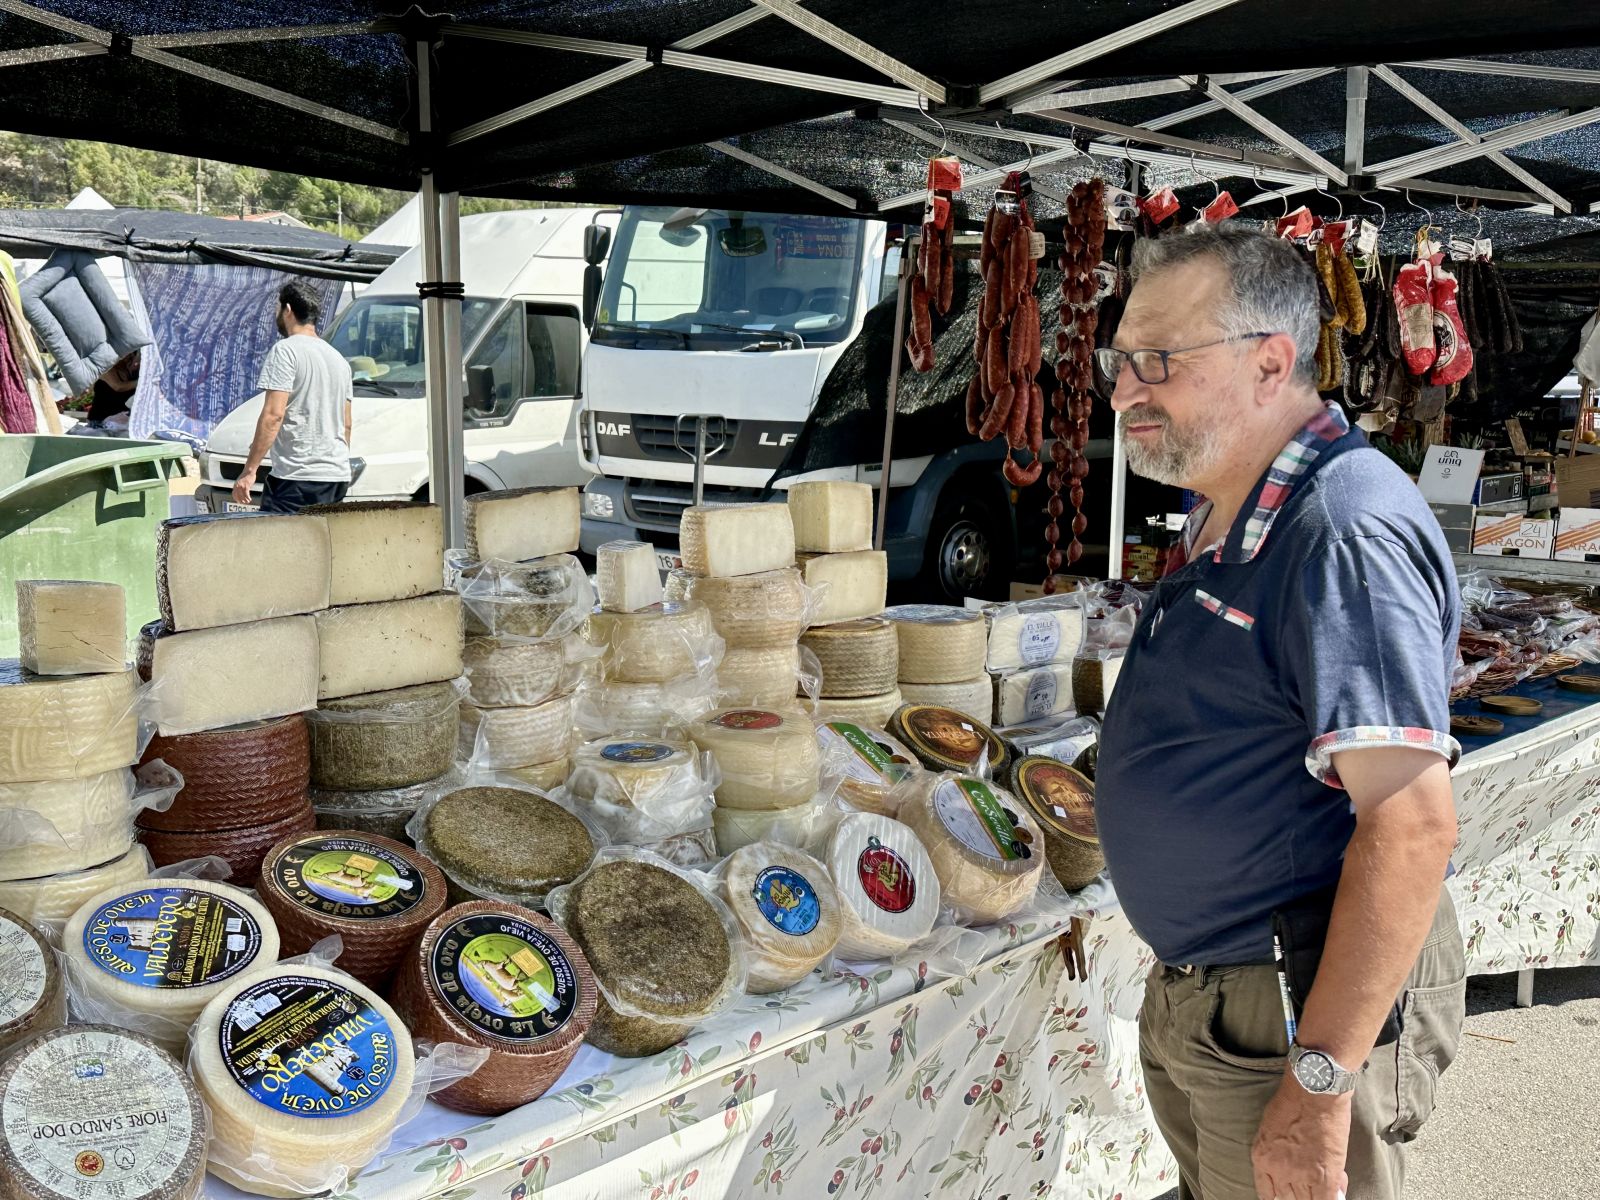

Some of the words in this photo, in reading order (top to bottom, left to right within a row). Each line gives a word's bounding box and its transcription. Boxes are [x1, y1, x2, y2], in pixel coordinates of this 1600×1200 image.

[596, 421, 631, 437] DAF
[759, 431, 799, 447] LF
[1438, 458, 1462, 467] uniq
[1521, 522, 1541, 537] 24
[970, 789, 1011, 846] CorSevilla
[321, 844, 347, 852] VIEJO
[349, 845, 377, 855] OVEJA
[378, 851, 389, 861] DE
[388, 857, 410, 876] QUESO
[283, 868, 301, 888] oro
[296, 889, 319, 904] de
[378, 899, 405, 912] La
[105, 894, 156, 919] OVEJA
[321, 902, 376, 916] oveja
[92, 919, 111, 935] DE
[143, 895, 185, 977] VALDEPERO
[500, 924, 525, 938] VIEJO
[440, 939, 459, 967] oro
[526, 934, 551, 954] OVEJA
[92, 937, 137, 974] QUESO
[548, 955, 560, 966] DE
[440, 971, 459, 993] de
[554, 967, 567, 994] QUESO
[456, 995, 504, 1030] oveja
[289, 1020, 307, 1036] CON
[510, 1020, 538, 1037] La
[262, 1030, 292, 1051] LECHE
[235, 1047, 264, 1068] CRUDA
[261, 1014, 374, 1093] VALDEPERO
[367, 1032, 389, 1087] QUESO
[280, 1092, 344, 1111] OVEJA
[345, 1083, 372, 1105] DE
[69, 1116, 124, 1135] SARDO
[126, 1110, 168, 1128] FIORE
[33, 1124, 66, 1140] DOP
